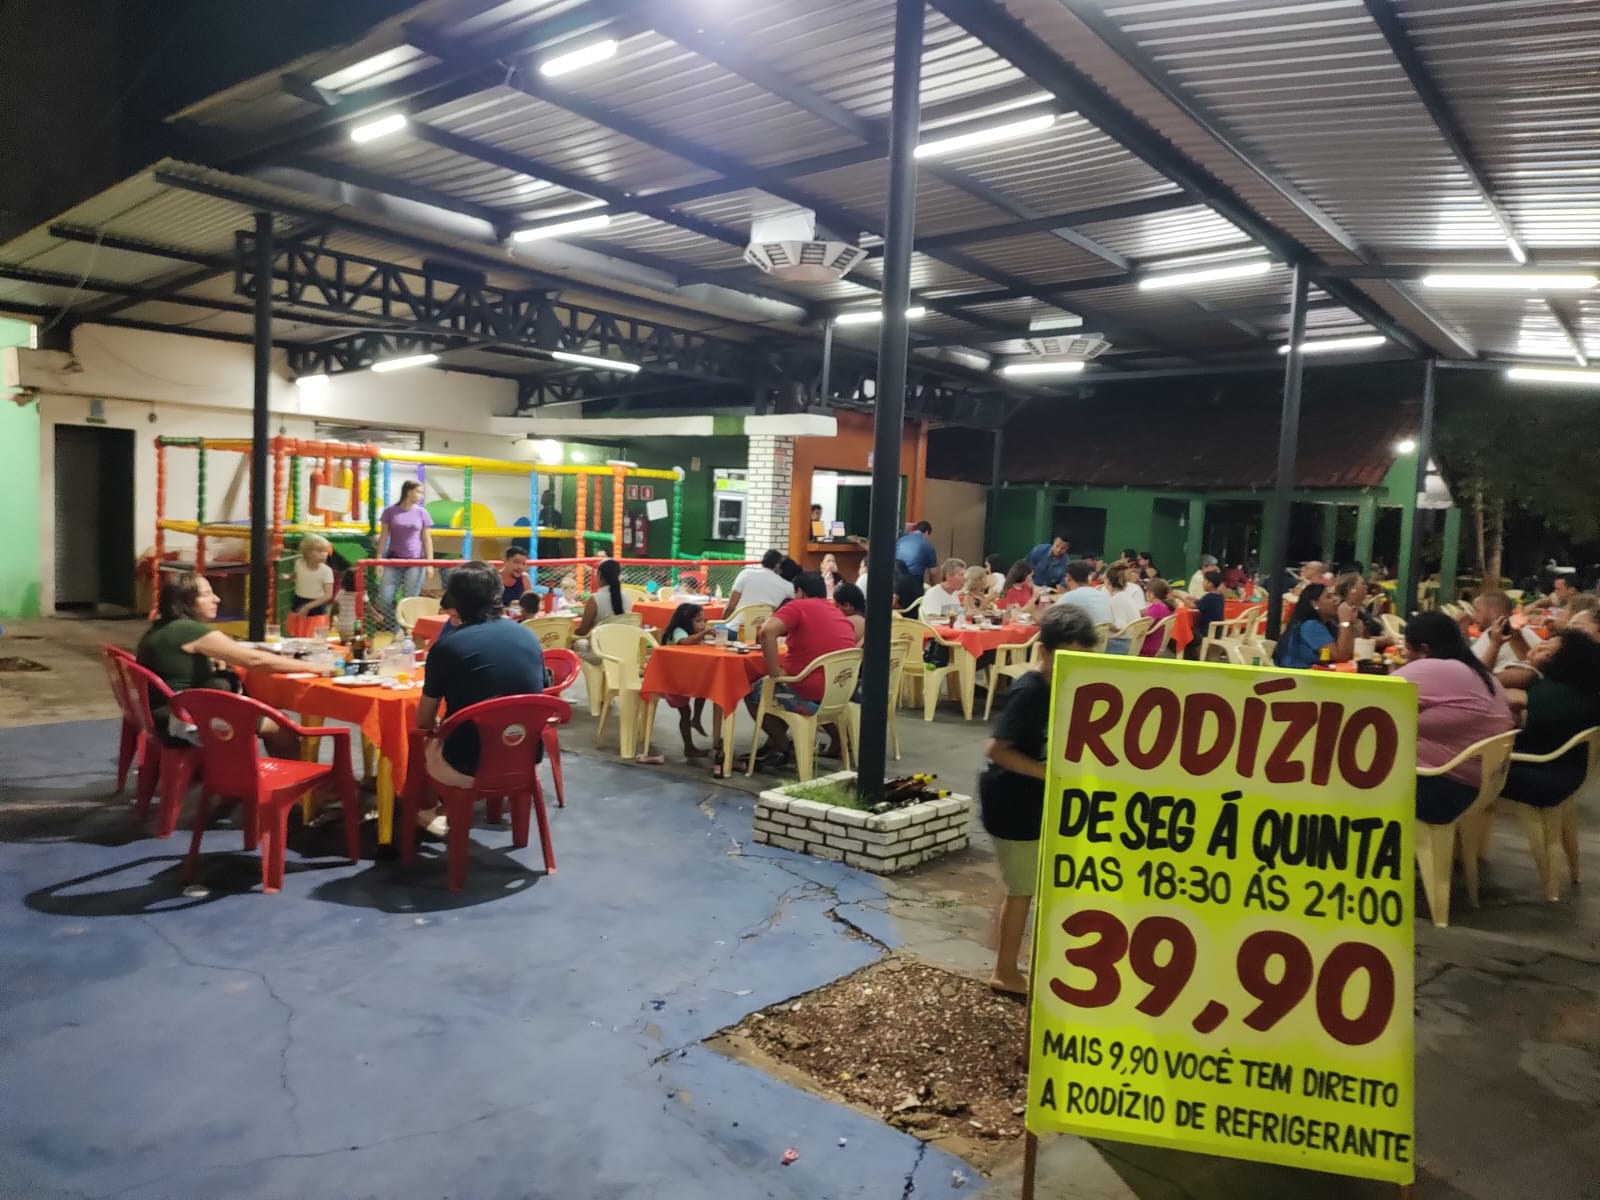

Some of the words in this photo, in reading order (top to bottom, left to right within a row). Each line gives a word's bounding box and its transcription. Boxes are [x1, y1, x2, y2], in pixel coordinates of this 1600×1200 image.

[1062, 677, 1399, 790] RODÍZIO
[1058, 787, 1118, 844] DE
[1119, 791, 1197, 854] SEG
[1206, 790, 1243, 861] Á
[1251, 808, 1403, 880] QUINTA
[1053, 853, 1124, 892] DAS
[1137, 860, 1232, 905] 18:30
[1243, 867, 1290, 912] ÁS
[1303, 880, 1404, 928] 21:00
[1048, 909, 1396, 1047] 39,90
[1042, 1029, 1103, 1066] MAIS
[1109, 1041, 1159, 1076] 9,90
[1164, 1047, 1235, 1085] VOCÊ
[1239, 1059, 1294, 1095] TEM
[1302, 1067, 1399, 1108] DIREITO
[1039, 1077, 1057, 1111] A
[1066, 1082, 1165, 1124] RODÍZIO
[1175, 1099, 1207, 1131] DE
[1215, 1104, 1411, 1164] REFRIGERANTE
